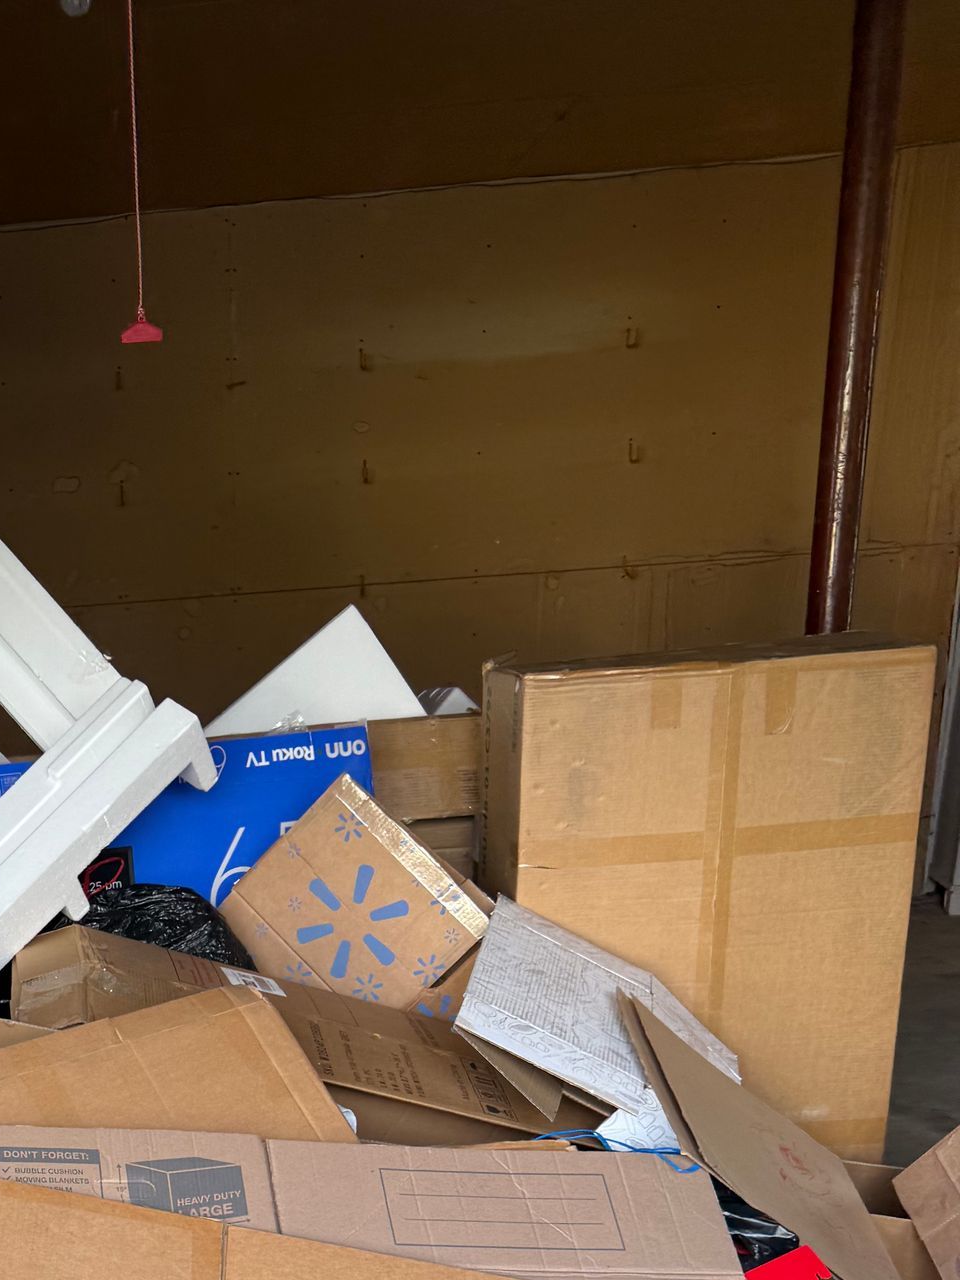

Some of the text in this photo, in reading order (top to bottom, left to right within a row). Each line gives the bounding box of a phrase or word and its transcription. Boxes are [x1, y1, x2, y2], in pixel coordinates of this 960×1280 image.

[245, 739, 366, 768] onn Roku TV
[3, 1149, 90, 1160] DON'T FORGET:
[14, 1167, 46, 1175] BUBBLE
[15, 1176, 90, 1185] MOVING BLANKETS
[176, 1190, 242, 1207] HEAVY DUTY
[178, 1202, 234, 1218] ARGE
